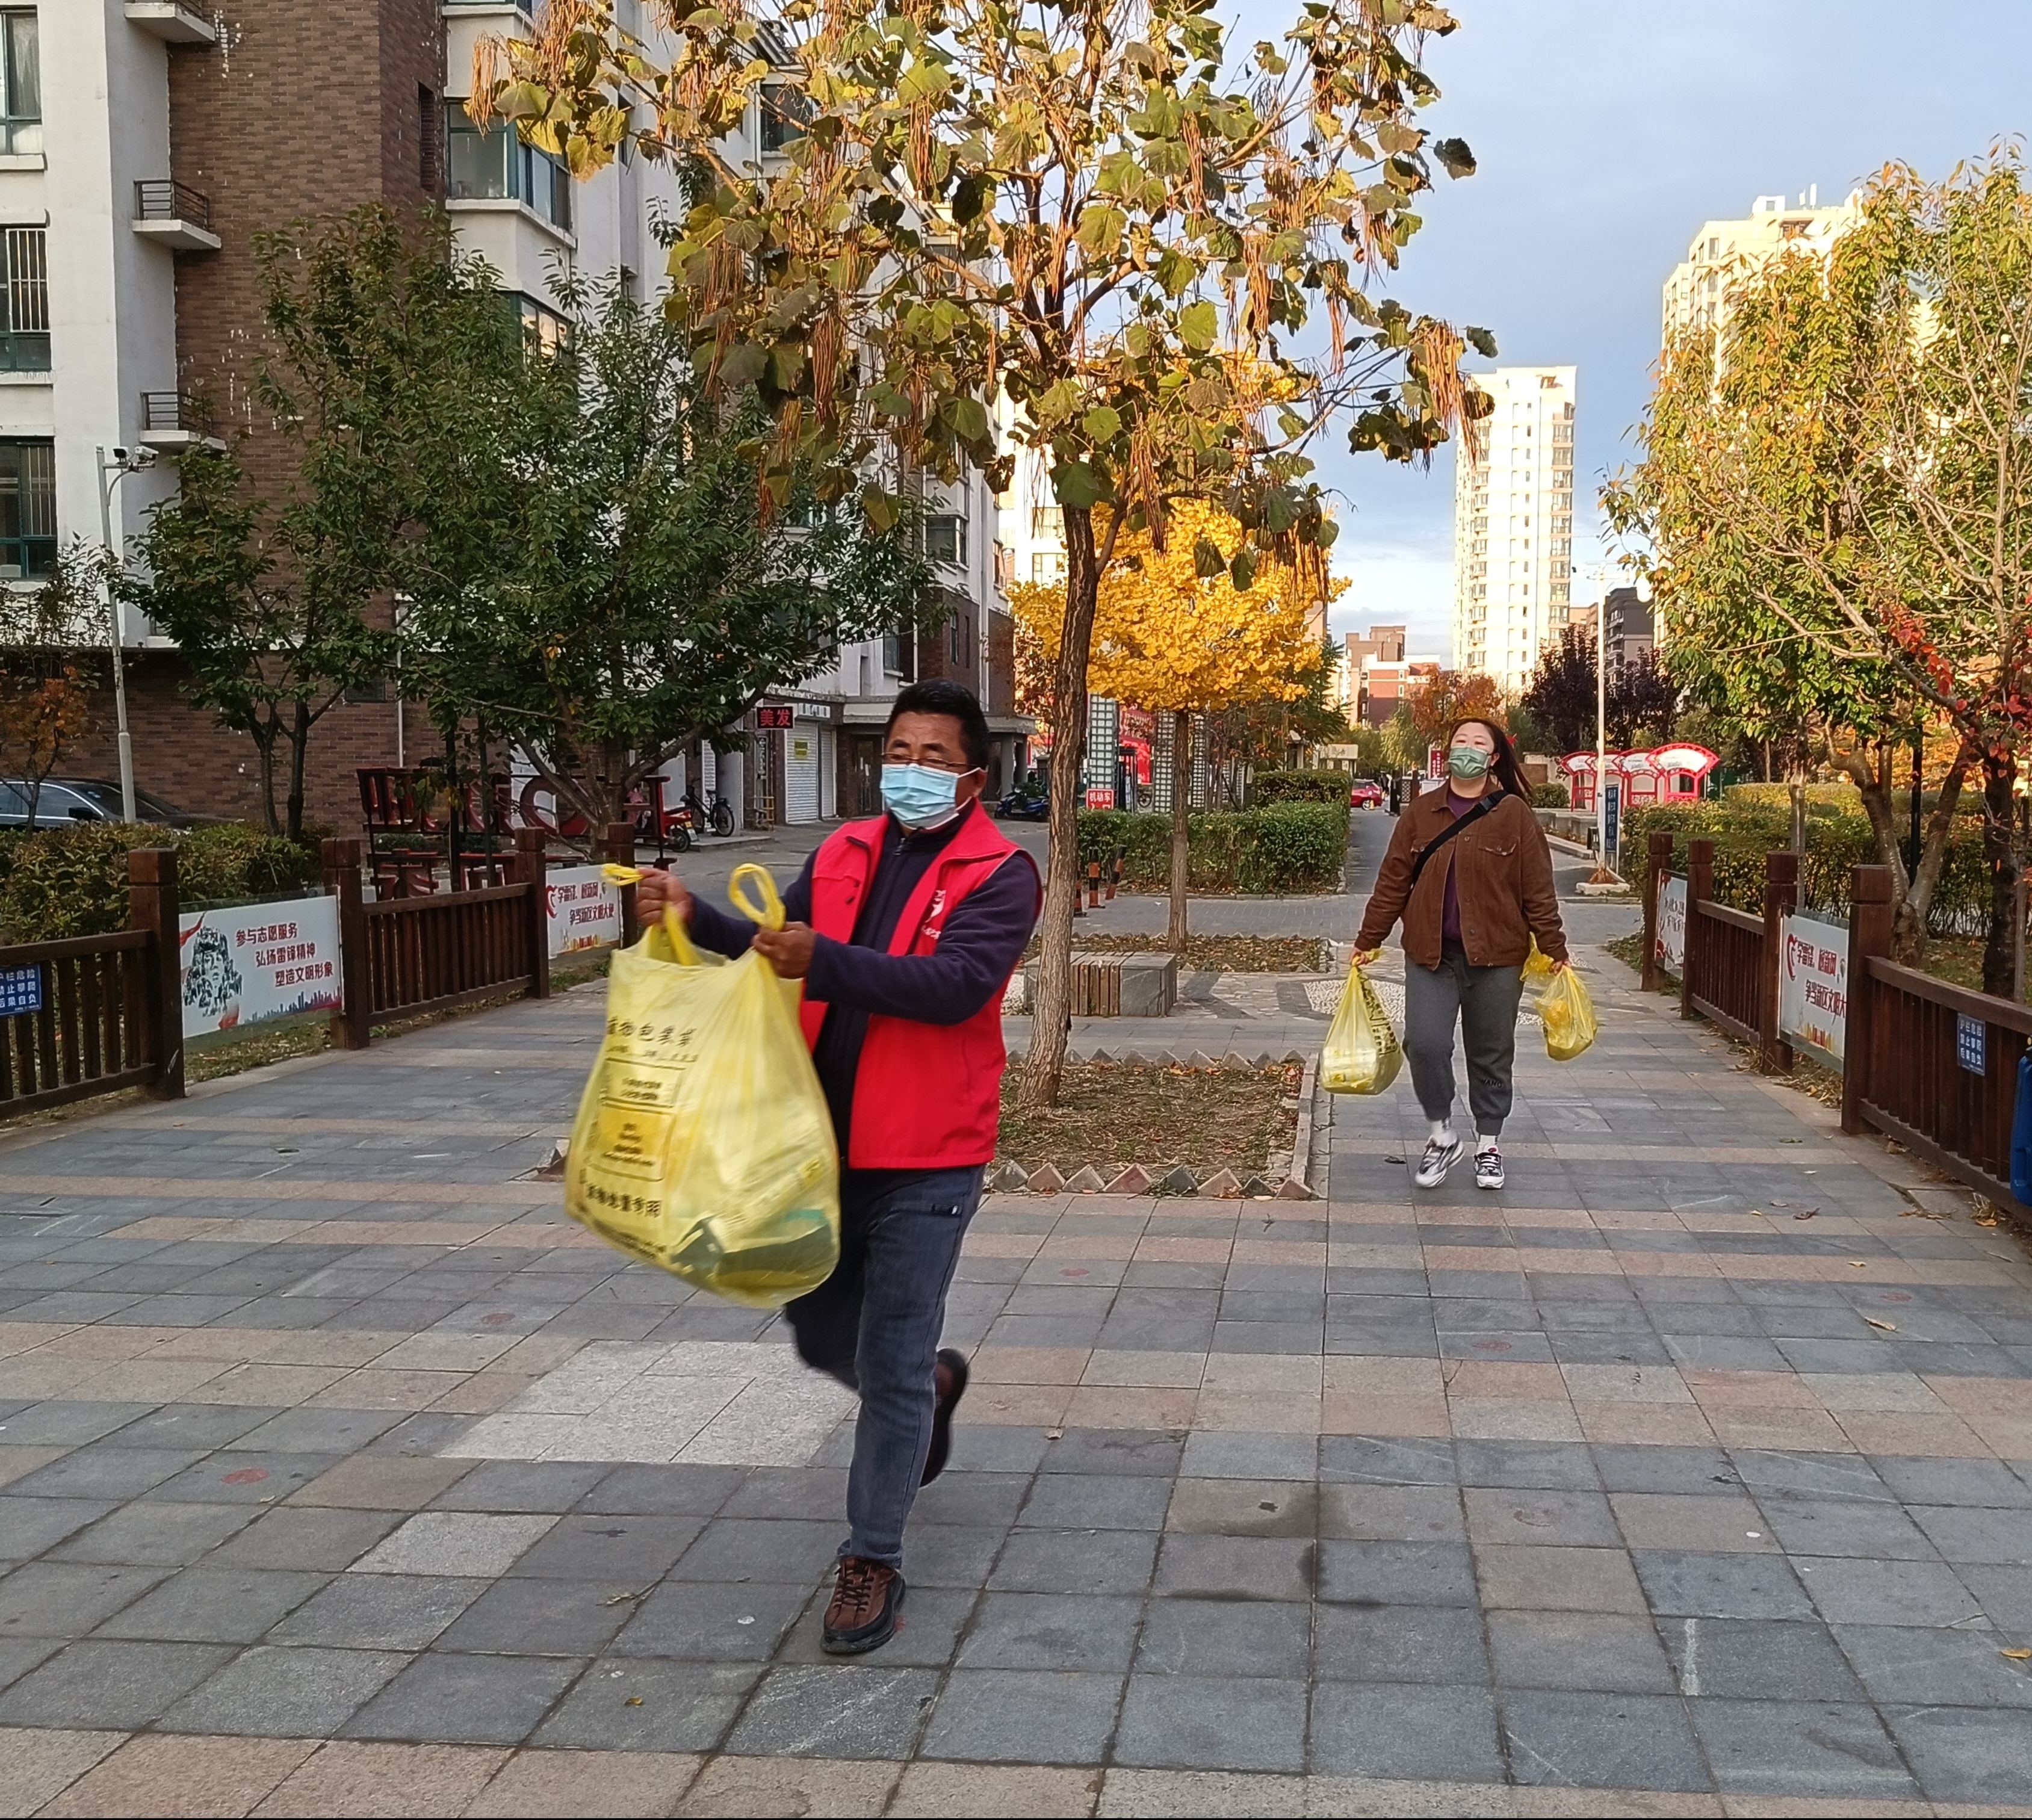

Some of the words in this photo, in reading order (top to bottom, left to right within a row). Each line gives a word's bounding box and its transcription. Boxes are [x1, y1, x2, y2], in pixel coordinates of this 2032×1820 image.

[760, 709, 791, 726] 美发
[1089, 791, 1111, 802] 机动车
[236, 923, 297, 947] 参与志愿服务
[256, 942, 315, 967] 弘扬雷锋精神
[276, 961, 333, 987] 塑造文明形象
